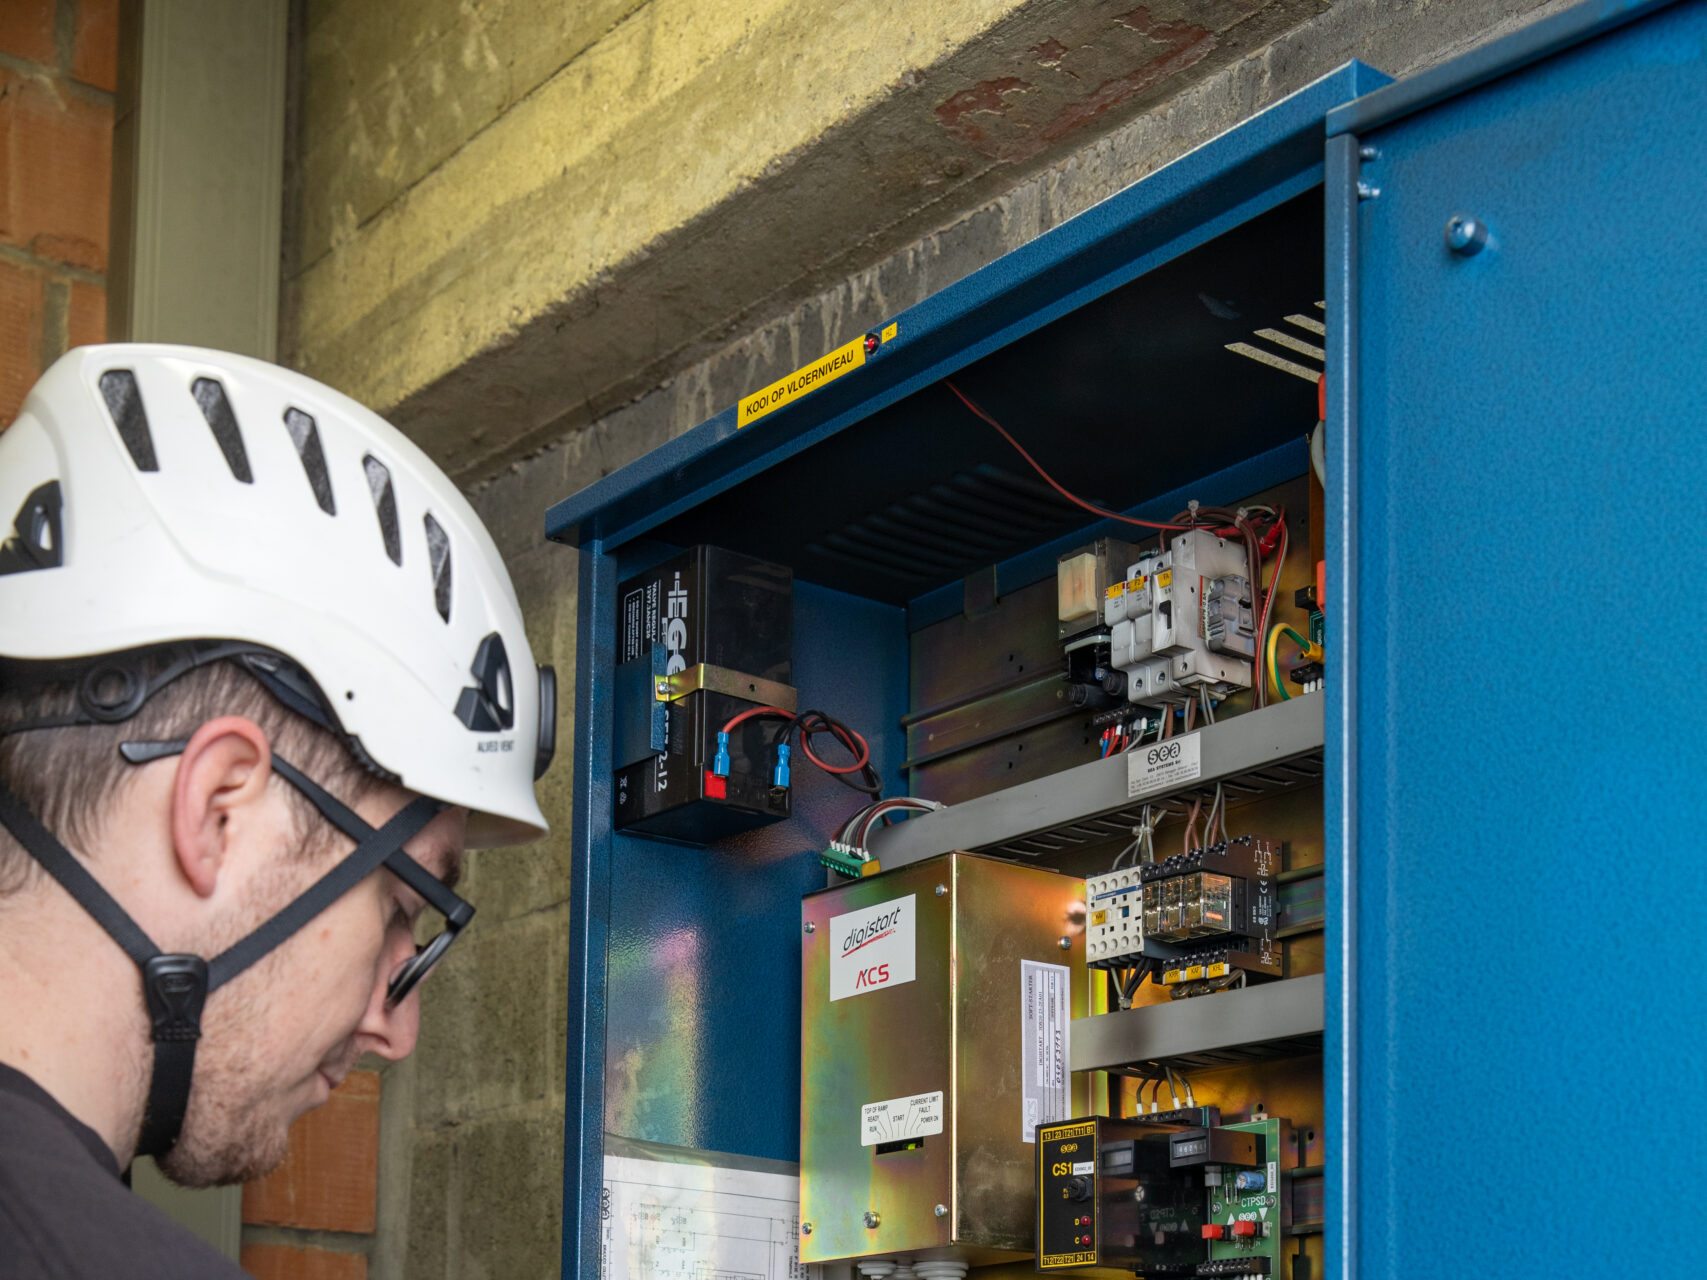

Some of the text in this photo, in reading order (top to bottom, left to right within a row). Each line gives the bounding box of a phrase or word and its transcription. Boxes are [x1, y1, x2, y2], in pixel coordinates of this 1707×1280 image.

[746, 350, 854, 416] KOOI OP VLOERNIVEAU
[843, 906, 901, 951] digistart
[856, 963, 889, 989] ACS
[893, 1114, 905, 1122] START
[1044, 1132, 1051, 1140] 13
[1055, 1131, 1062, 1139] 23
[1052, 1161, 1072, 1176] CS1
[1241, 1196, 1266, 1208] CTPSD
[1074, 1236, 1080, 1244] C
